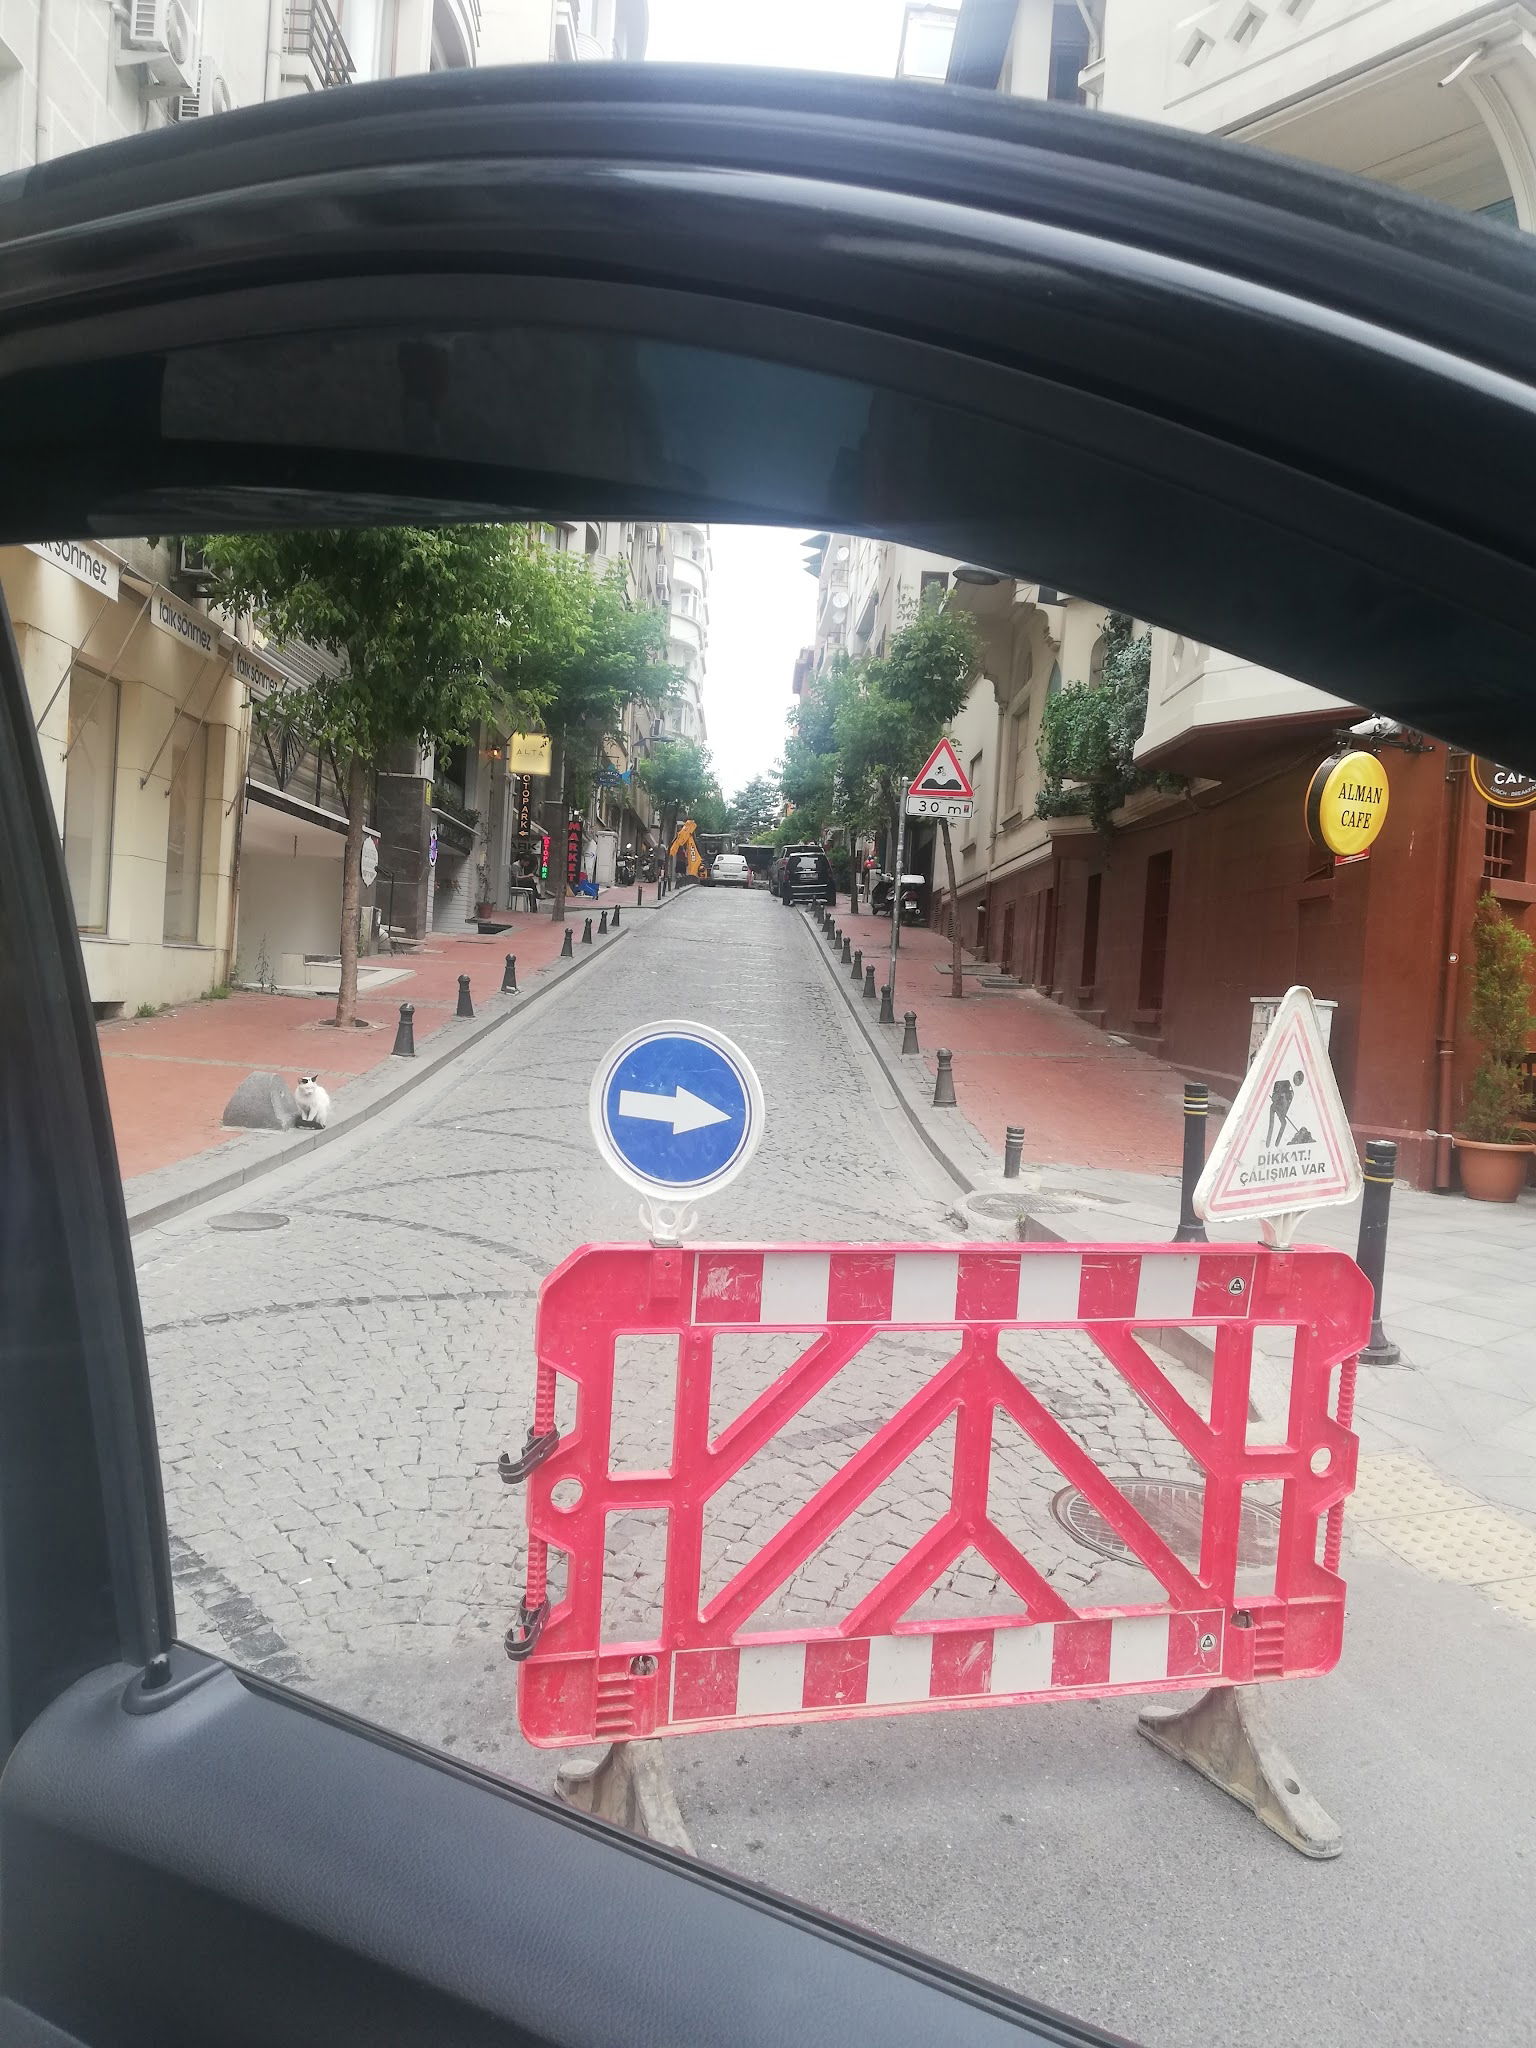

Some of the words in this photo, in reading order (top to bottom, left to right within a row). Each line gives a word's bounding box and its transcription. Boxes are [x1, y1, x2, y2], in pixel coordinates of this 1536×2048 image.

[159, 598, 177, 629] faik
[177, 614, 211, 651] sönmez
[516, 748, 544, 757] ALTA
[520, 774, 531, 828] OTOPARK
[1338, 783, 1383, 804] ALMAN
[918, 800, 939, 812] 30
[947, 806, 961, 814] m
[1341, 810, 1372, 829] CAFE
[568, 821, 581, 881] MARKET
[1239, 1166, 1297, 1187] ÇALIŞMA
[1301, 1162, 1325, 1175] VAR
